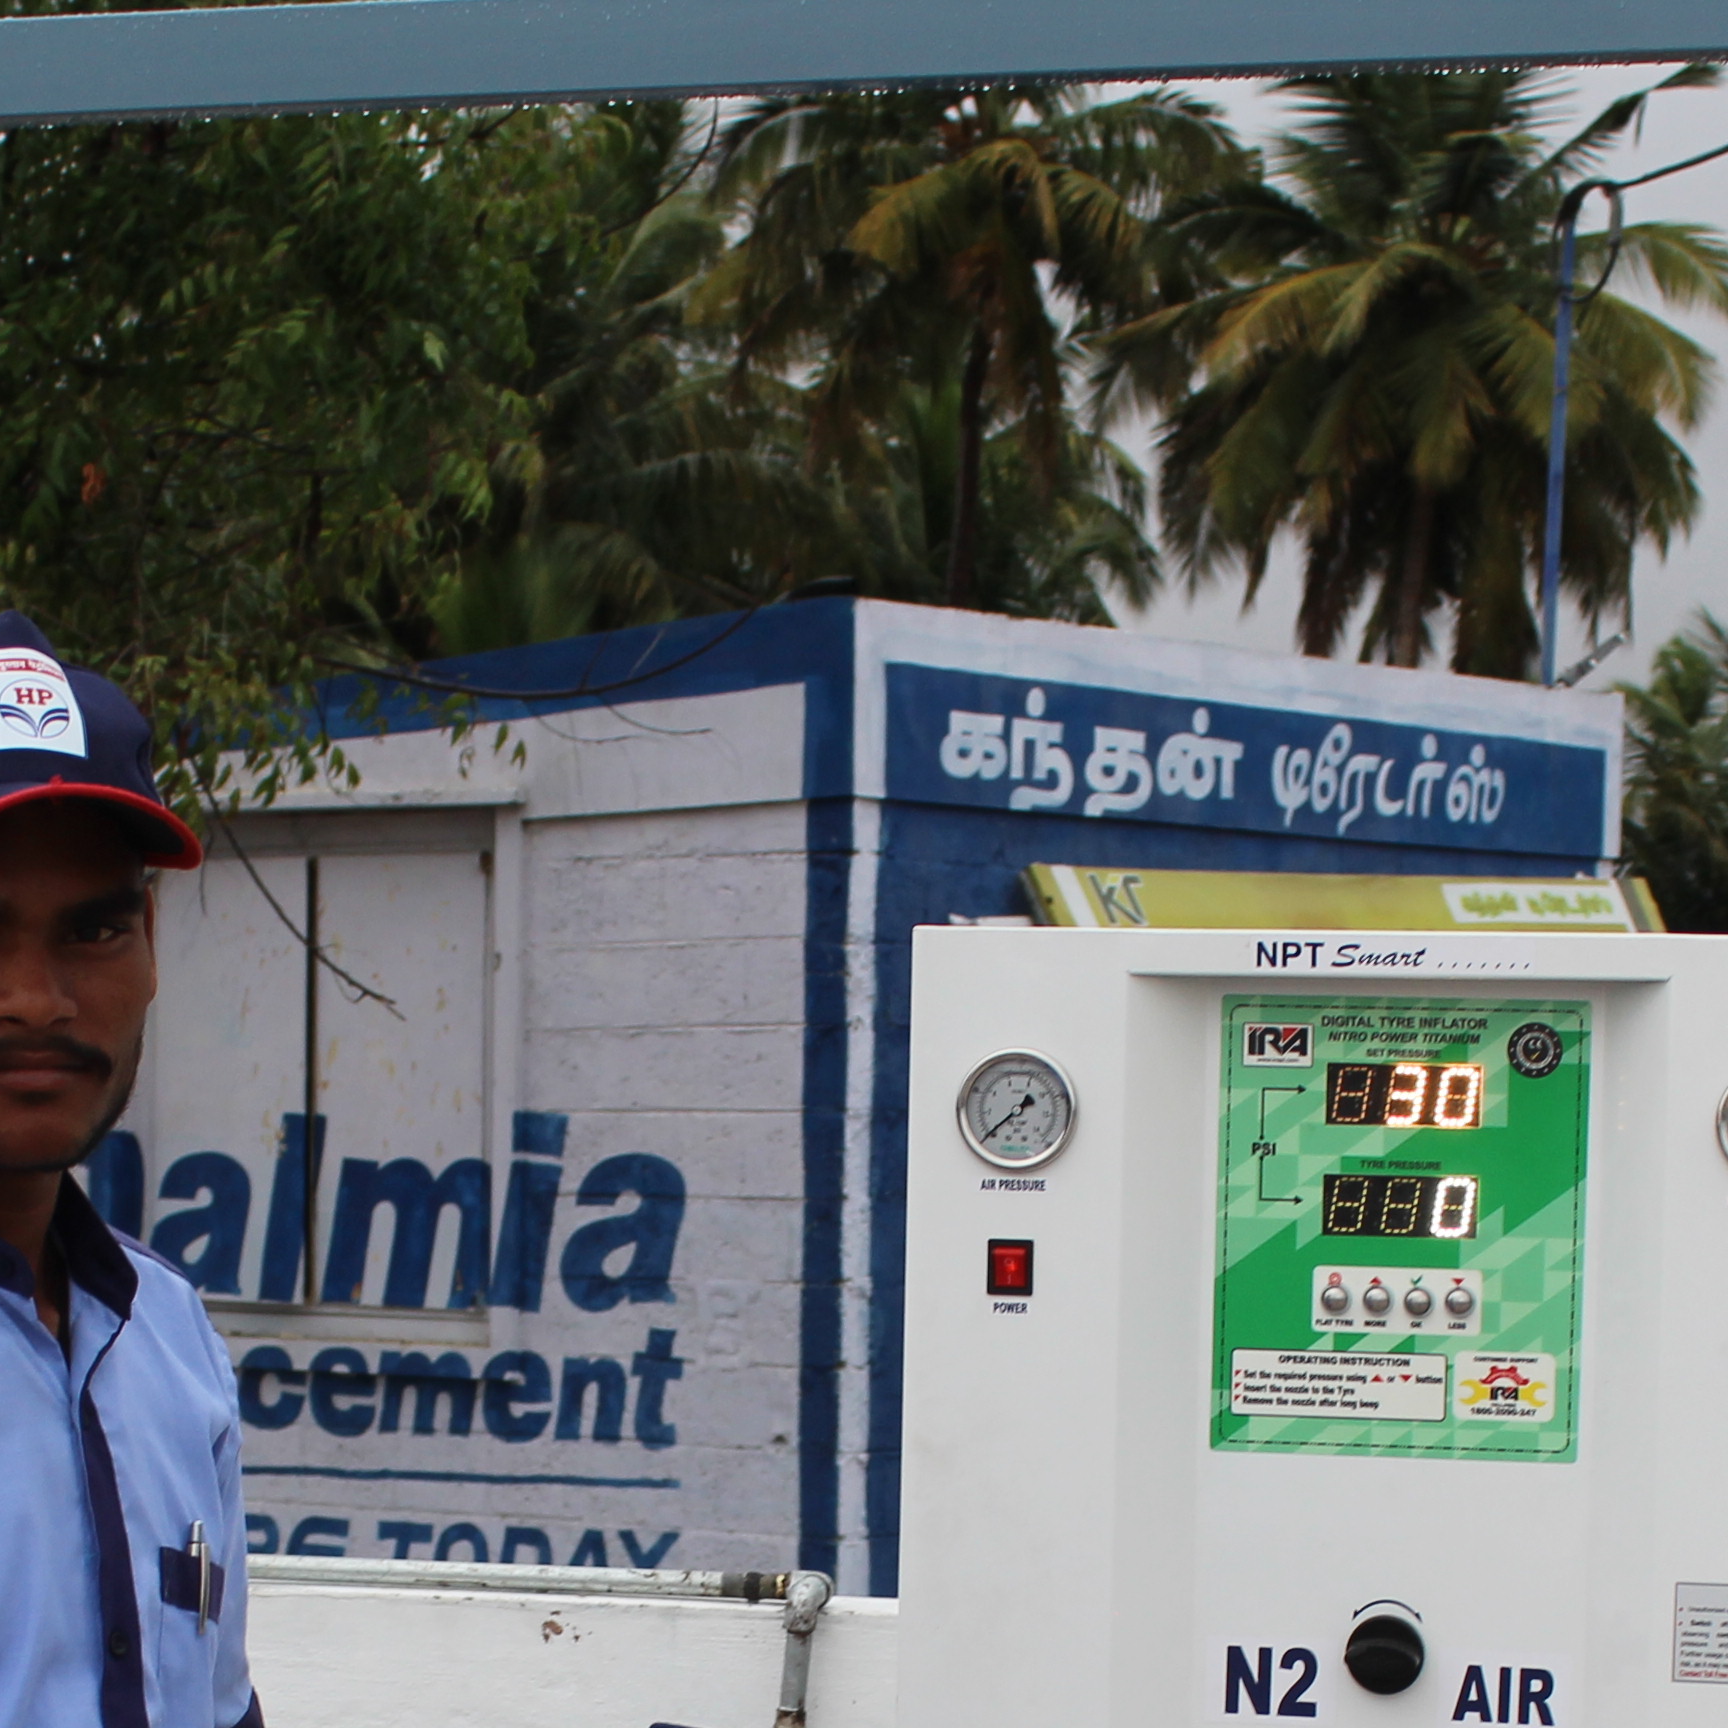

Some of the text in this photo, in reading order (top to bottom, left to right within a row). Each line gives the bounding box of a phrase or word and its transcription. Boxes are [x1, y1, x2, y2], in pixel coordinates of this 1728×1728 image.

[14, 687, 53, 705] HP
[939, 687, 1244, 817] கந்தன்
[1256, 941, 1427, 969] NPT Smart
[1322, 1015, 1488, 1030] DIGITAL TYRE INFLATOR
[1247, 1027, 1309, 1056] IRA
[1328, 1031, 1481, 1044] NITRO POWER TITANIUM
[1366, 1048, 1441, 1058] SET PRESSURE
[1386, 1064, 1480, 1128] 30
[1252, 1142, 1276, 1156] PSI
[1359, 1160, 1442, 1171] TYRE PRESSURE
[980, 1179, 1046, 1191] AIR PRESSURE
[993, 1302, 1027, 1313] POWER
[1278, 1355, 1411, 1367] OPERATING INSTRUCTION
[238, 1328, 683, 1451] cement
[1224, 1645, 1555, 1726] N2 AIR
